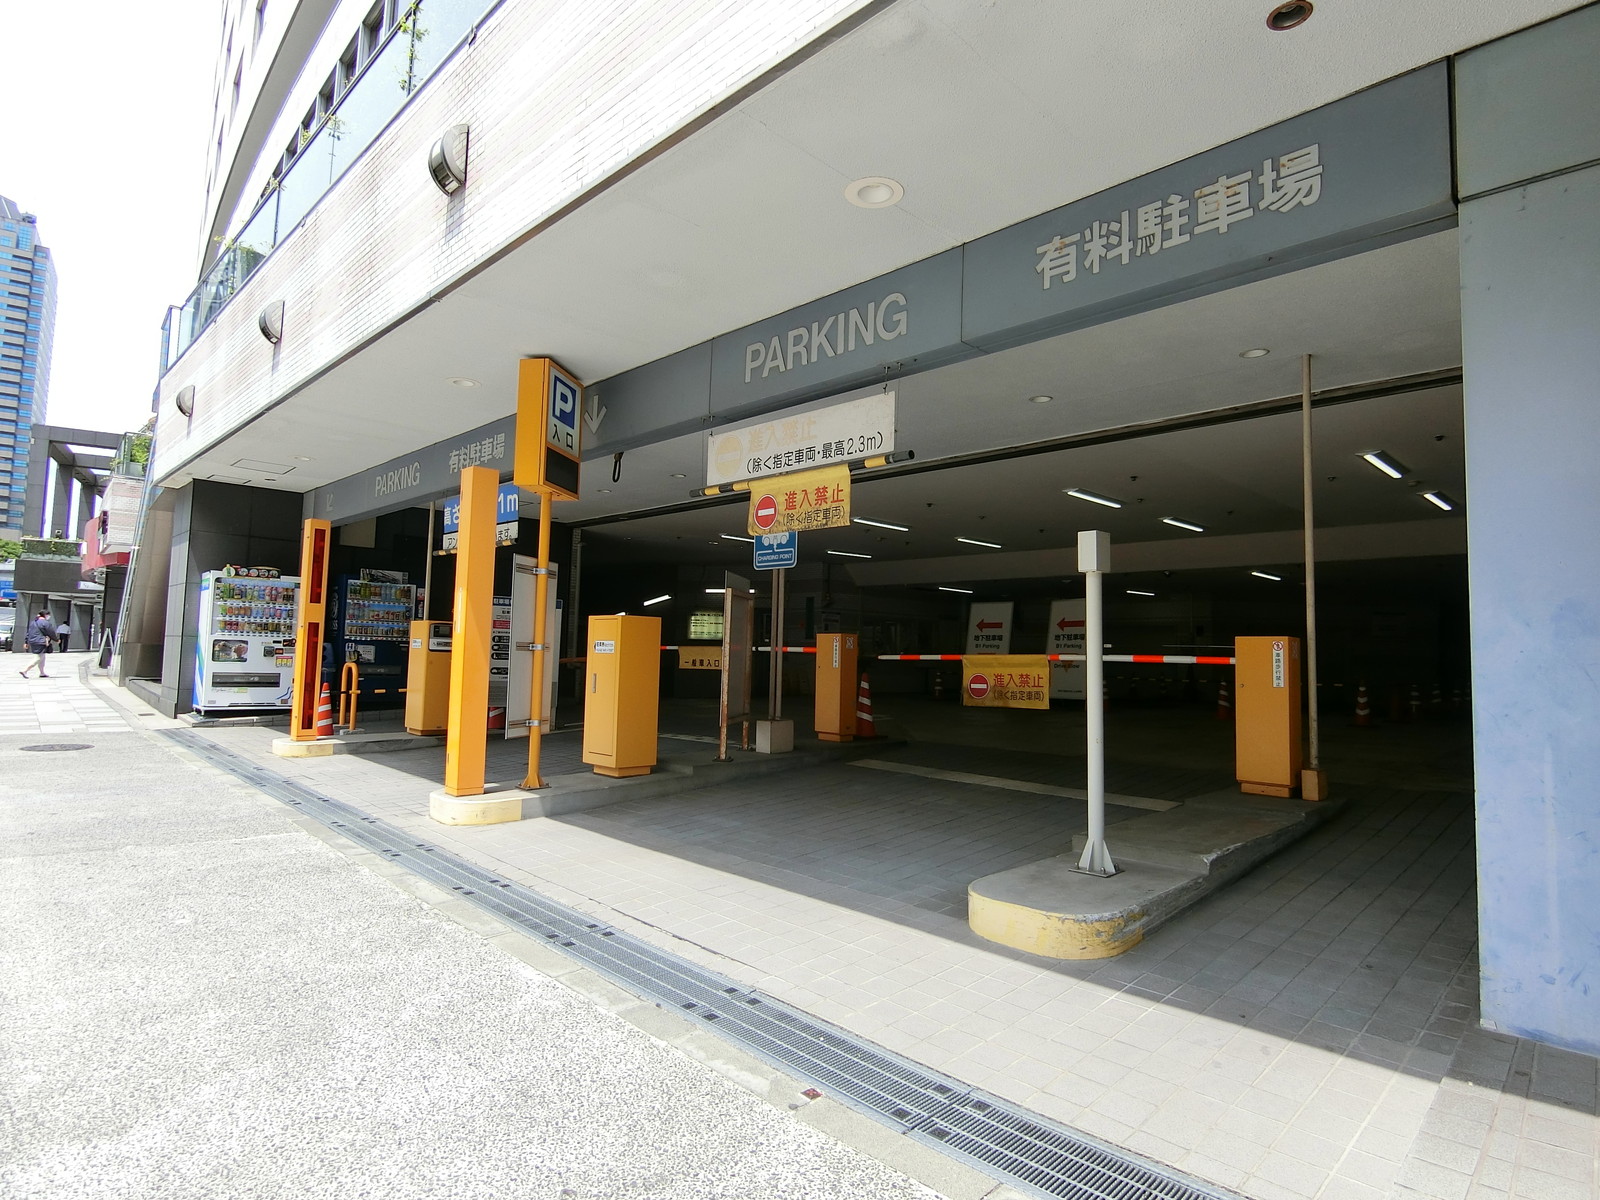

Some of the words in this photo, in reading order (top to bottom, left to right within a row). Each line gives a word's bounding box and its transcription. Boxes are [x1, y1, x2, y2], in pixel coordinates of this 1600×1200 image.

[1034, 143, 1324, 290] 有料駐車場
[744, 292, 908, 384] PARKING
[555, 380, 573, 417] P
[552, 423, 573, 450] 入口
[748, 417, 817, 453] 進入禁止
[449, 433, 505, 473] 有料駐車場
[375, 462, 420, 496] PARKING
[783, 483, 845, 512] 進入禁止
[782, 505, 846, 527] (除く指定車両)
[993, 673, 1044, 688] 進入禁止
